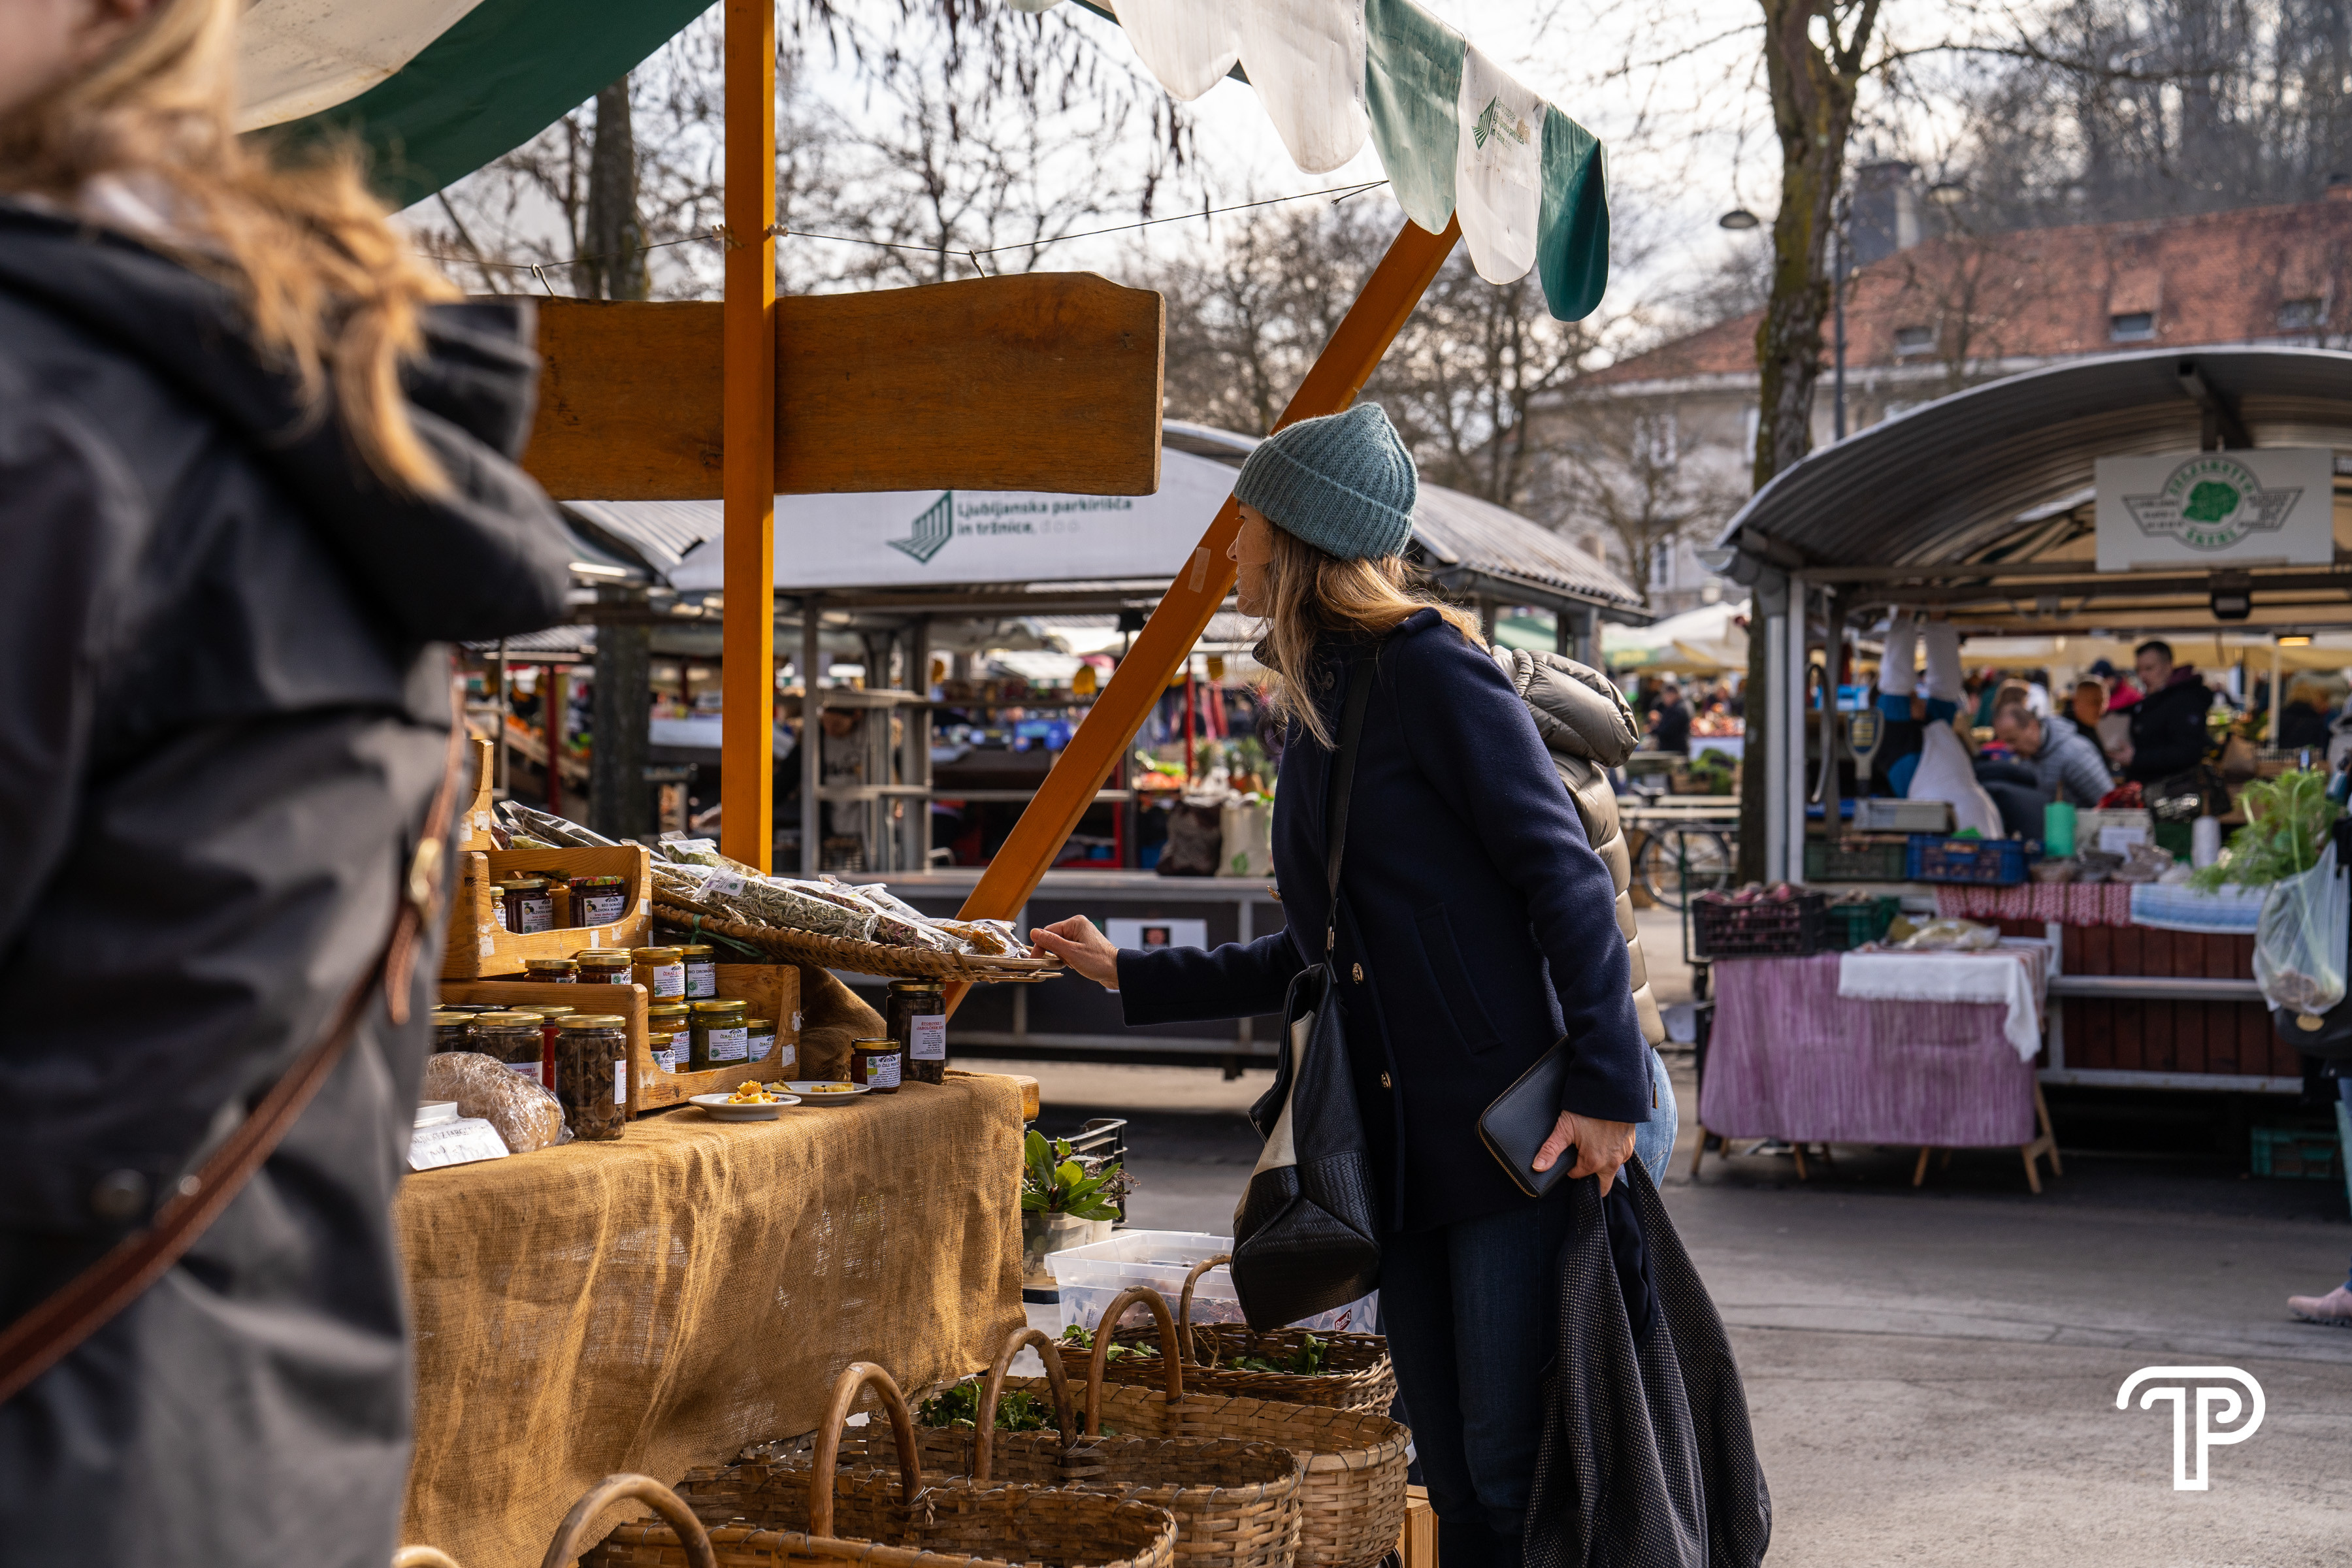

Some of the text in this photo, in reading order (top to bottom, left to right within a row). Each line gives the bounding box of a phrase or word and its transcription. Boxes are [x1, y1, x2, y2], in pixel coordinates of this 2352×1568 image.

[1490, 124, 1496, 137] in
[956, 501, 1048, 520] Ljubljanska
[956, 522, 973, 535] in
